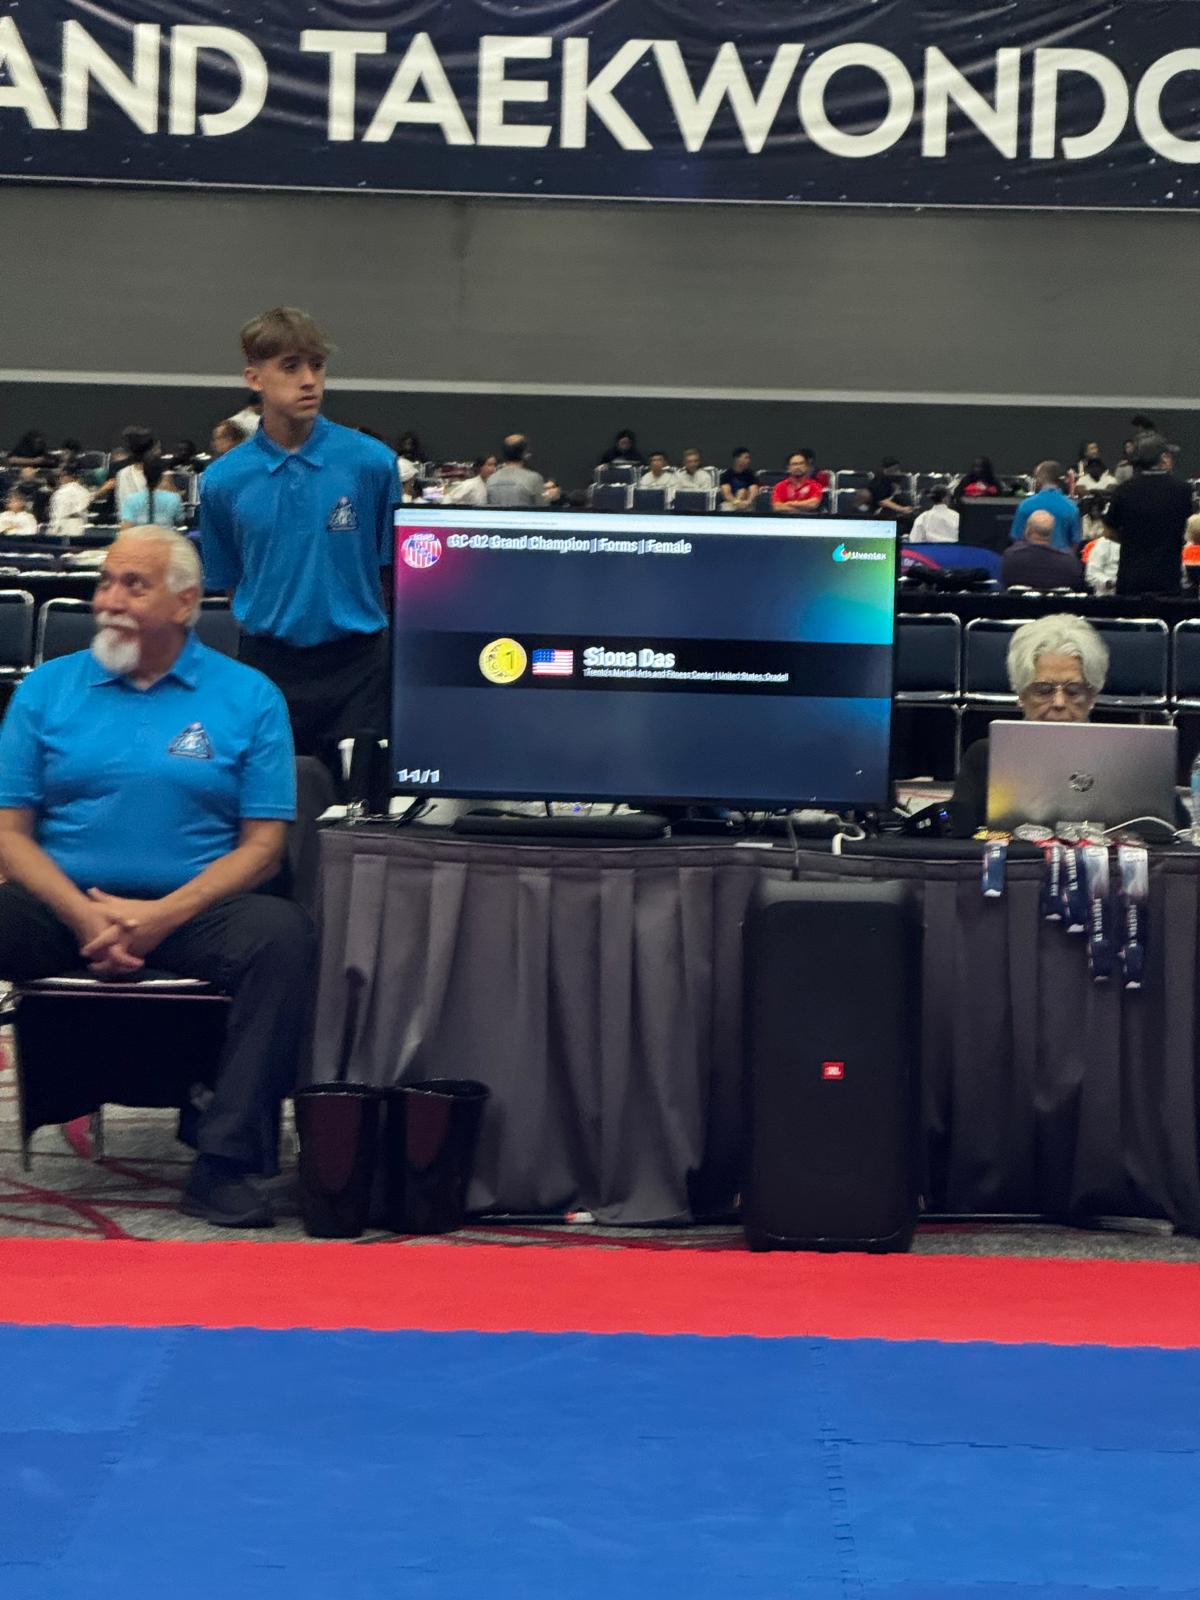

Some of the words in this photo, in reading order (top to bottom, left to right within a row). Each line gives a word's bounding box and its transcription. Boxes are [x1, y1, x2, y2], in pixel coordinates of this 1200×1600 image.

[0, 16, 268, 136] AND
[301, 30, 1200, 164] TAEKWONDO
[447, 534, 489, 548] GC-02
[489, 535, 528, 549] Grand
[527, 536, 590, 553] Champion
[597, 538, 638, 552] Forms
[645, 539, 692, 554] Female
[583, 647, 637, 667] Siona
[638, 648, 676, 668] Das
[610, 668, 636, 678] Martial
[635, 668, 651, 678] Arts
[650, 669, 664, 679] and
[664, 669, 689, 680] Fitness
[690, 670, 713, 681] Center
[718, 671, 739, 681] United
[763, 672, 789, 682] Oradell
